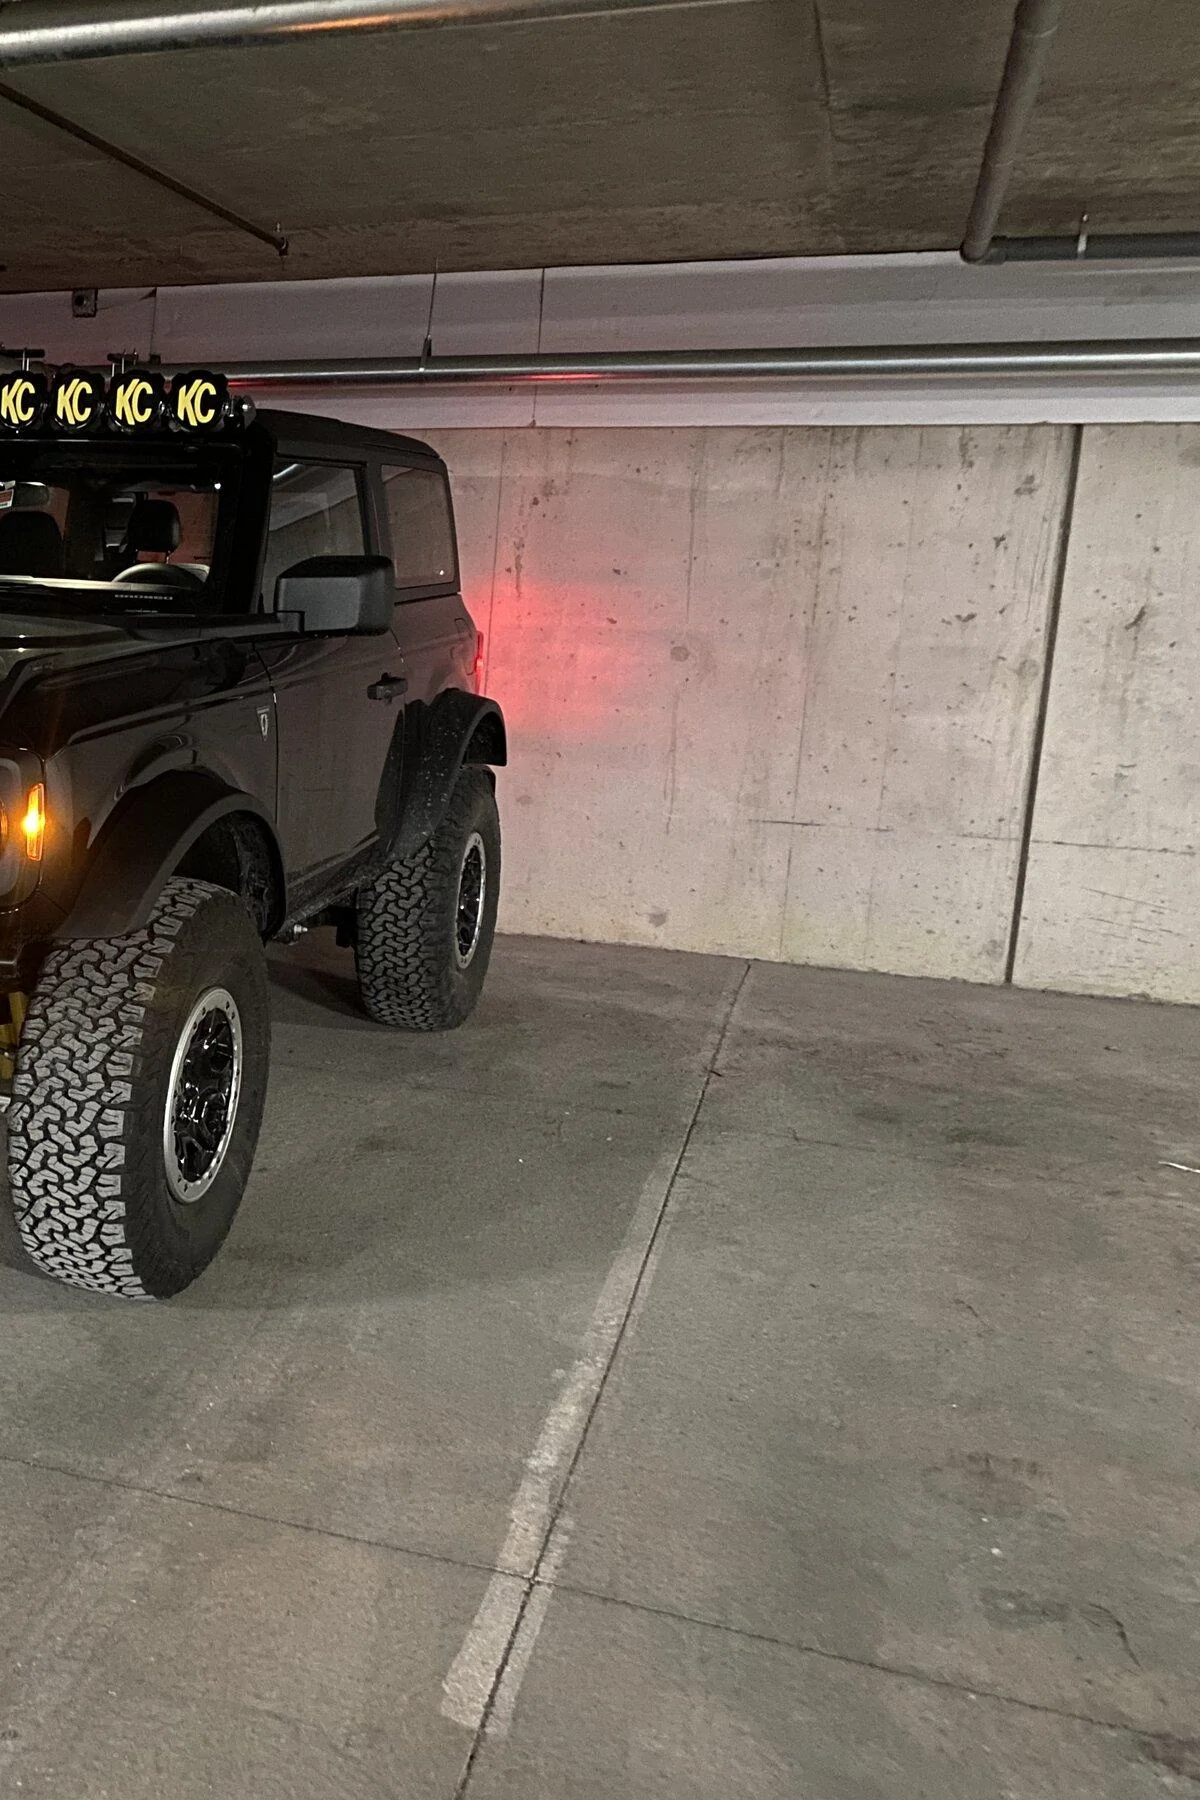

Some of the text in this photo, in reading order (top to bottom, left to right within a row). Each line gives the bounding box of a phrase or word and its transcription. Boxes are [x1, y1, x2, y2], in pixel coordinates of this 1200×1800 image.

[1, 379, 34, 424] KC
[57, 379, 92, 424] KC
[116, 379, 153, 425] KC
[178, 379, 217, 427] KC
